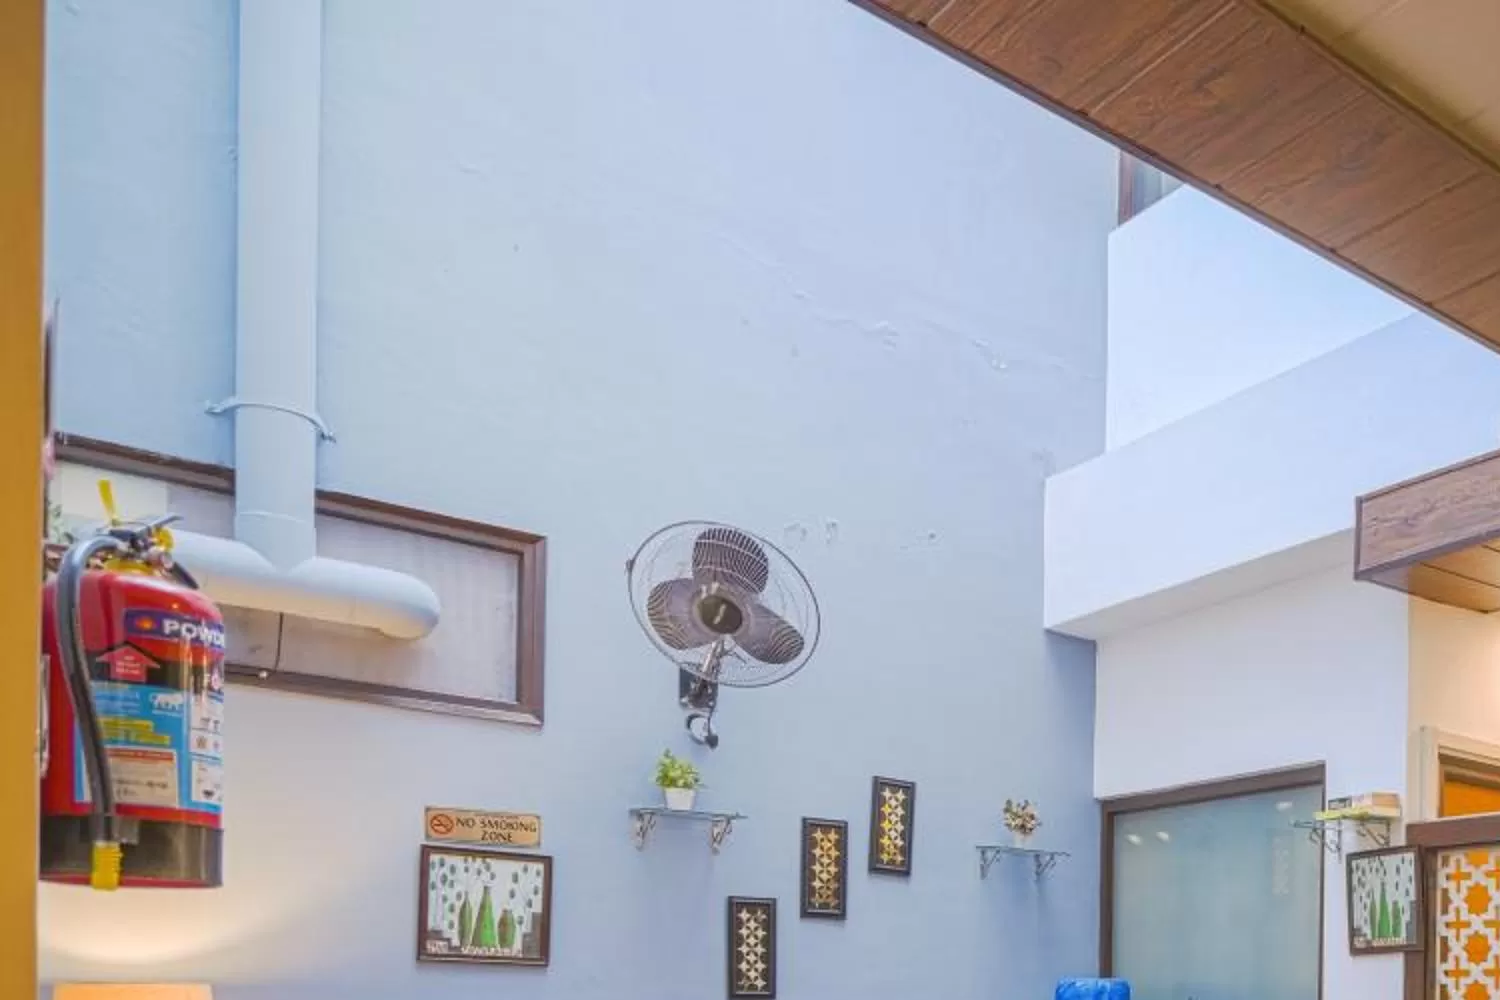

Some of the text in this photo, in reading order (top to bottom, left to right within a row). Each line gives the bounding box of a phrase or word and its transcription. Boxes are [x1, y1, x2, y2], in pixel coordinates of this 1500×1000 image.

[455, 816, 537, 833] NO SMOKING
[481, 830, 513, 843] ZONE
